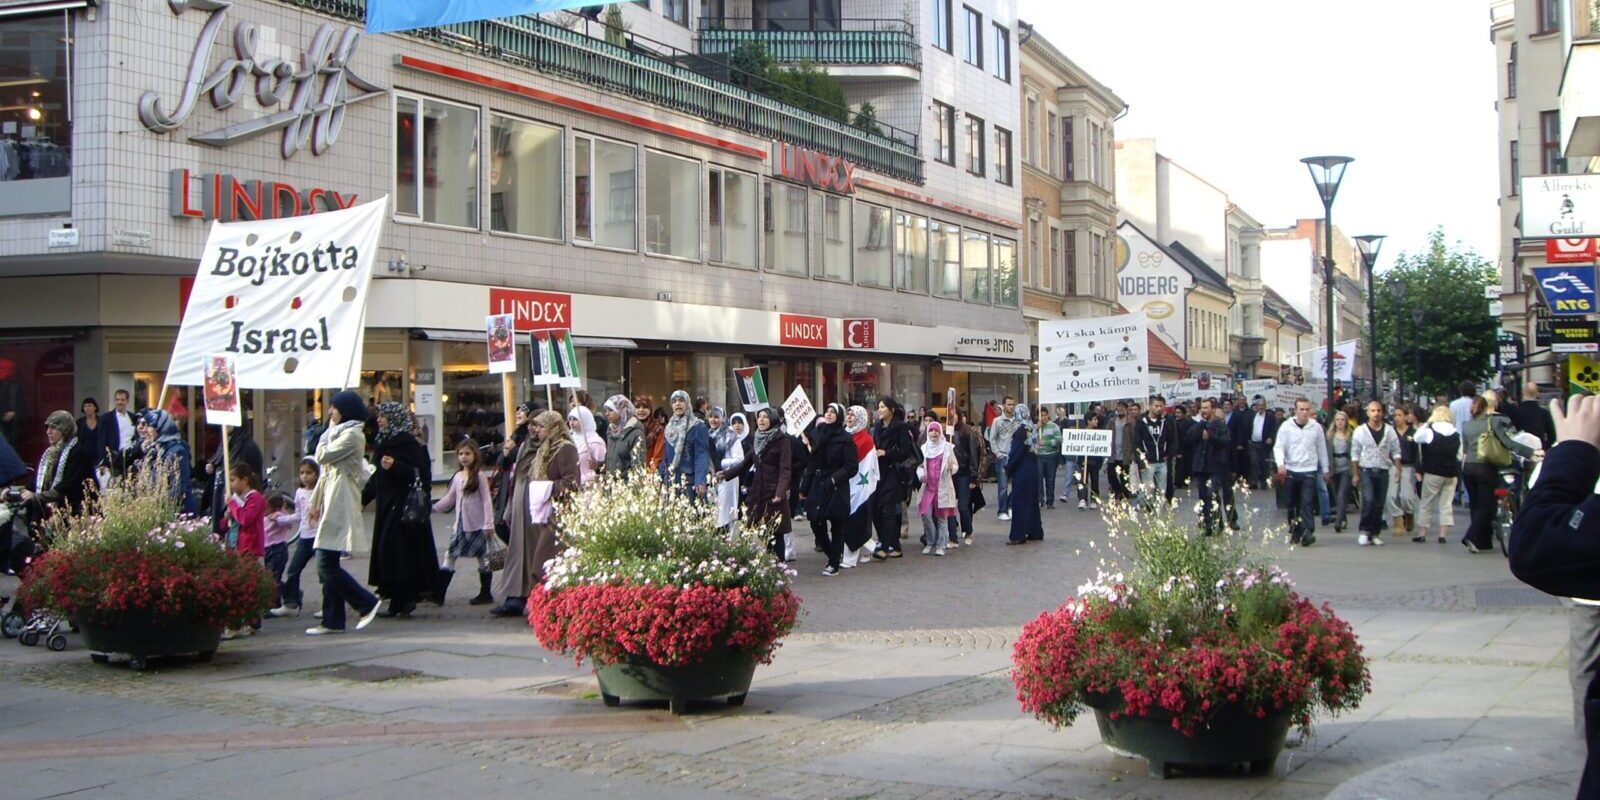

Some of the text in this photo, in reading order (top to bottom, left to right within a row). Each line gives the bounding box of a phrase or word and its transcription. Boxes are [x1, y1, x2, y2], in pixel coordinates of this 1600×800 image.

[777, 141, 856, 194] LINDEX
[1540, 178, 1593, 191] Albrekts
[172, 168, 358, 220] LINDEX
[1549, 221, 1584, 234] Guld
[211, 241, 358, 286] Bojkotta
[1556, 299, 1590, 310] ATG
[226, 316, 331, 354] Israel
[785, 322, 823, 340] LINDEX
[1056, 325, 1137, 338] Vi ska kämpa
[957, 337, 990, 345] Jerns
[987, 338, 1014, 353] erns
[1093, 353, 1109, 362] för
[1056, 377, 1140, 392] al Qods friheten
[1068, 431, 1107, 442] Intifadan
